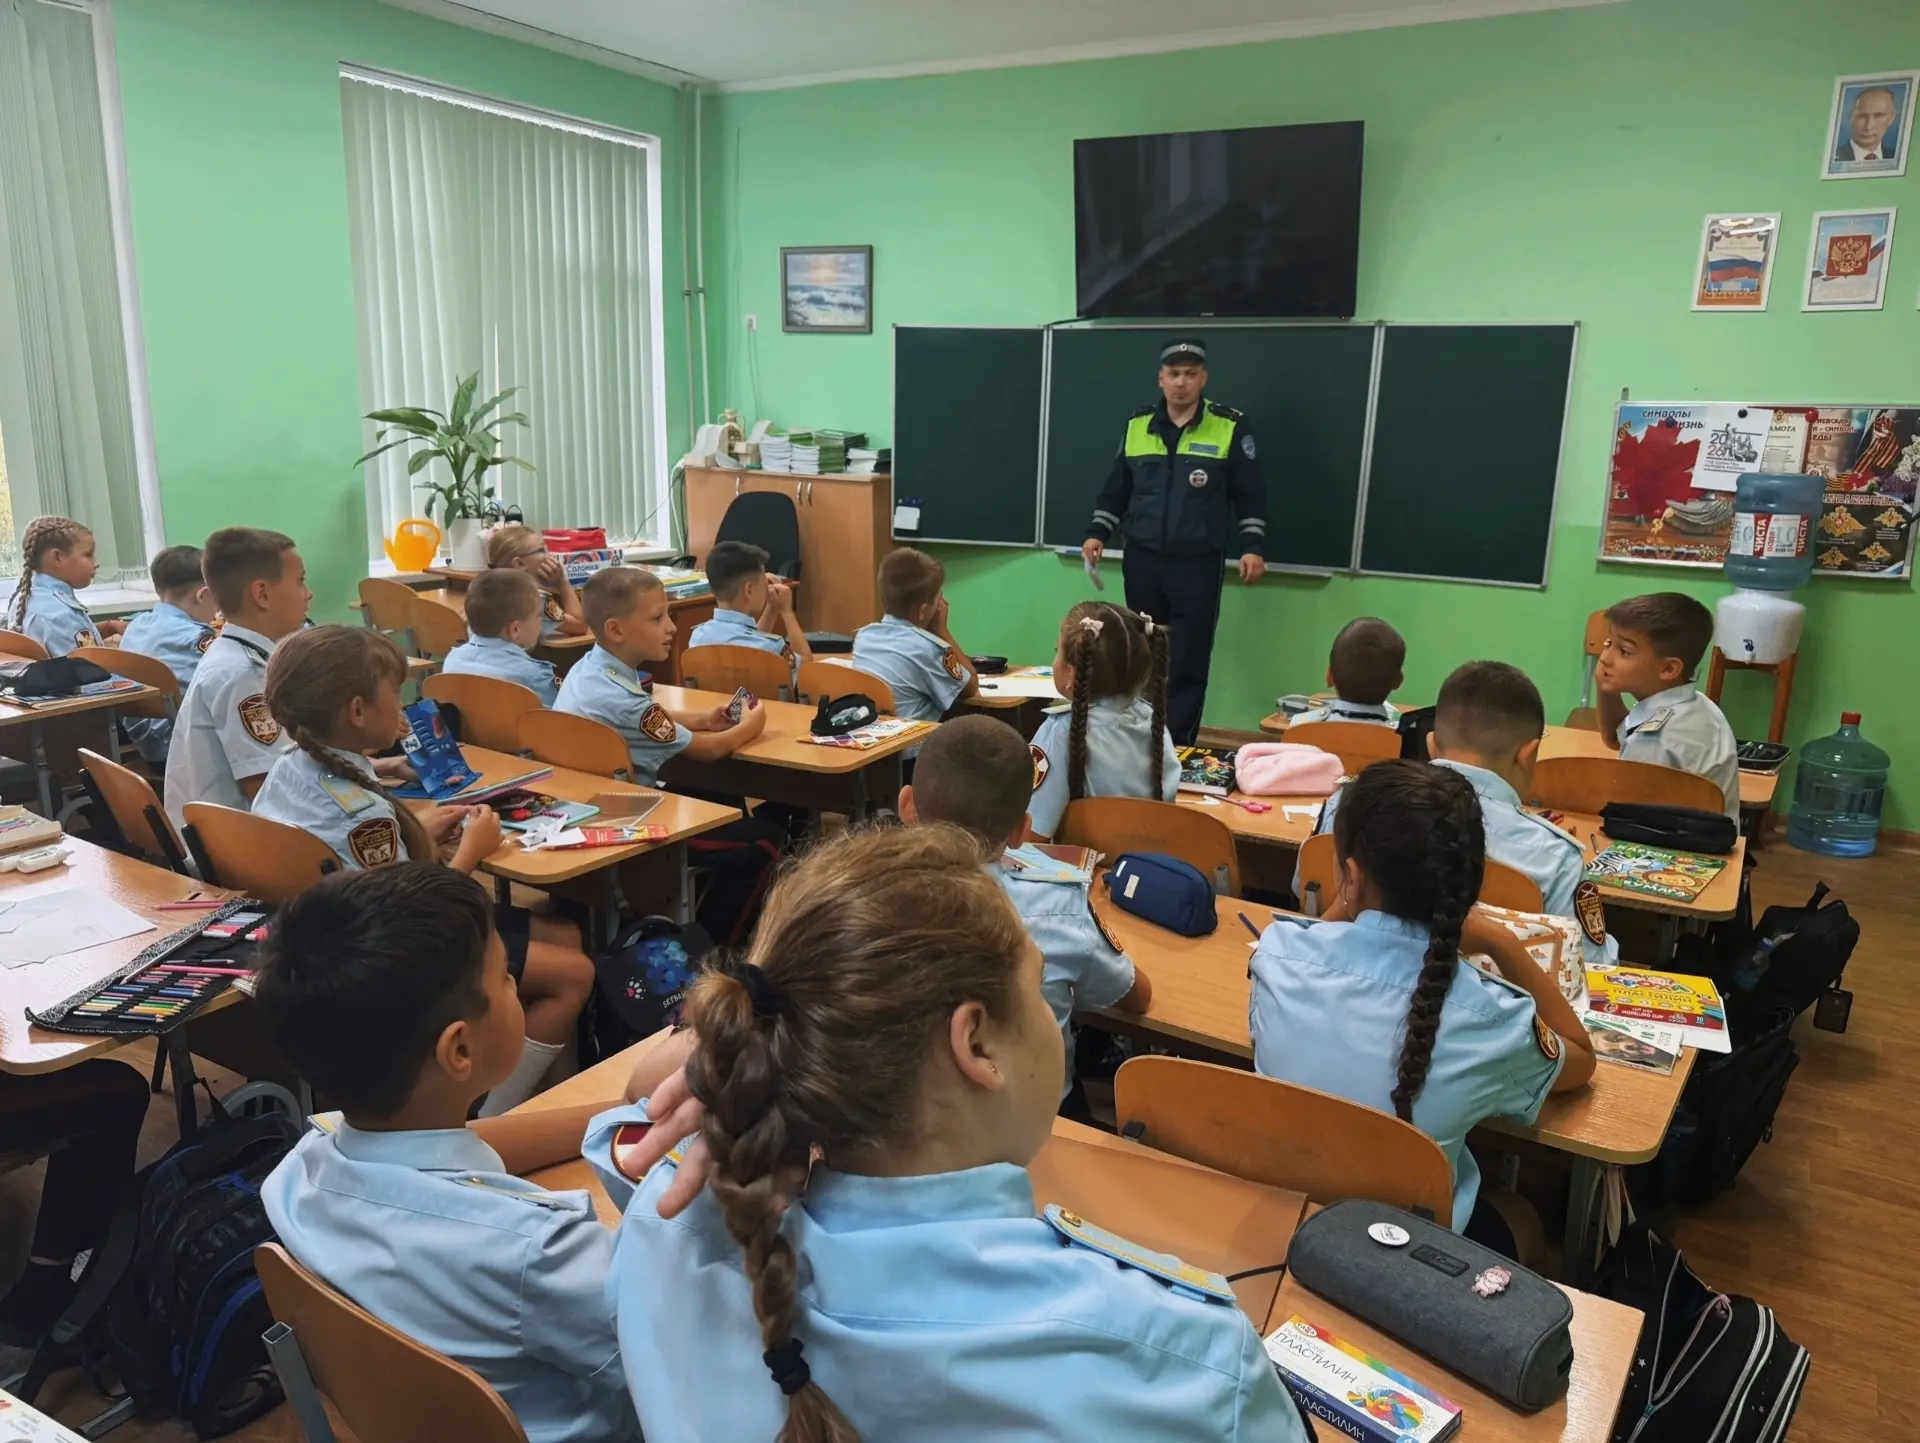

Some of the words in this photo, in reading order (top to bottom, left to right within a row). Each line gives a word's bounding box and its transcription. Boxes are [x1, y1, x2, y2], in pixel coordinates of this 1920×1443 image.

[1642, 410, 1691, 418] СИМВОЛЫ
[1706, 445, 1724, 457] 26
[1709, 432, 1728, 445] 20
[1754, 518, 1767, 552] ЧИСТА
[1797, 519, 1809, 552] ЧИСТА
[1283, 1327, 1327, 1355] PLASTICINE
[1274, 1332, 1358, 1384] ПЛАСТИЛИН
[1294, 1390, 1366, 1442] ПЛАСТИЛИН
